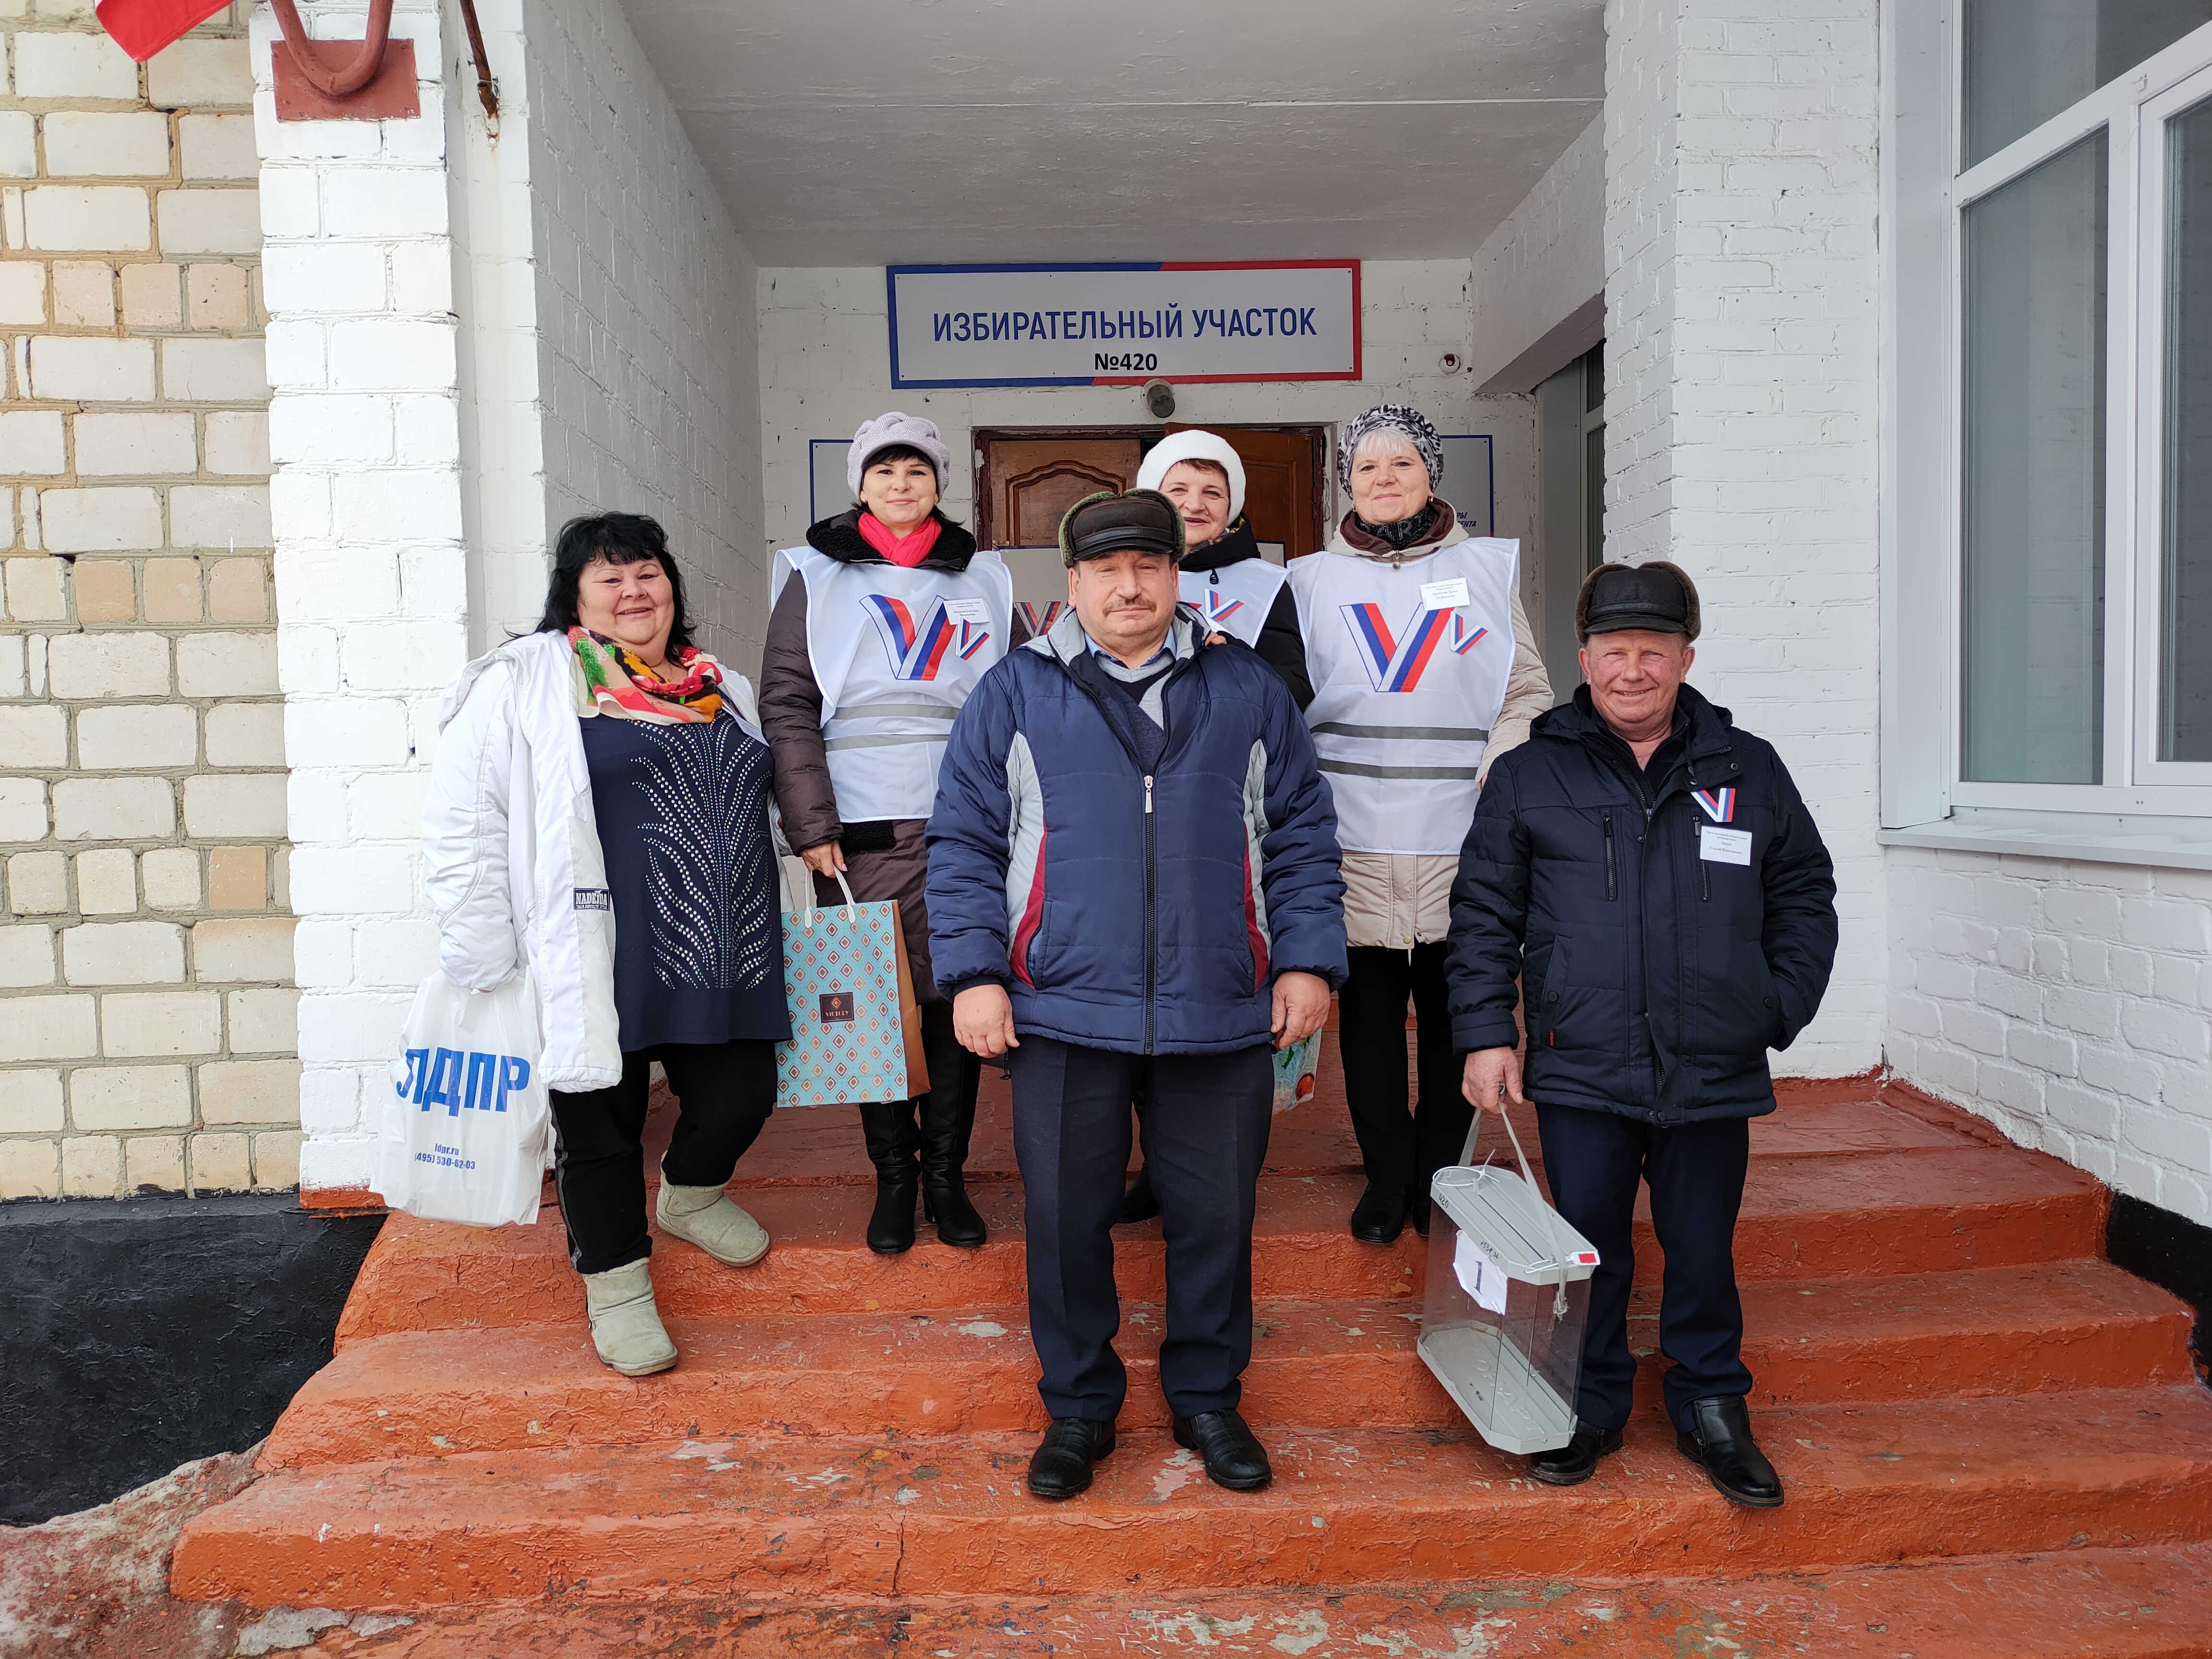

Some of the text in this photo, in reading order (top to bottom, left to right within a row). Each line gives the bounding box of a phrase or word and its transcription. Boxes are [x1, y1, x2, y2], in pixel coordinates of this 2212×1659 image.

[933, 302, 1318, 342] ИЗБИРАТЕЛЬНЫЙ УЧАСТОК
[1094, 353, 1158, 371] №420
[396, 1047, 530, 1117] ЛДПР
[434, 1143, 459, 1156] ldpr.ru
[414, 1153, 476, 1170] (495) 530-62-03
[1439, 1193, 1449, 1208] 420
[1473, 1261, 1482, 1296] 1
